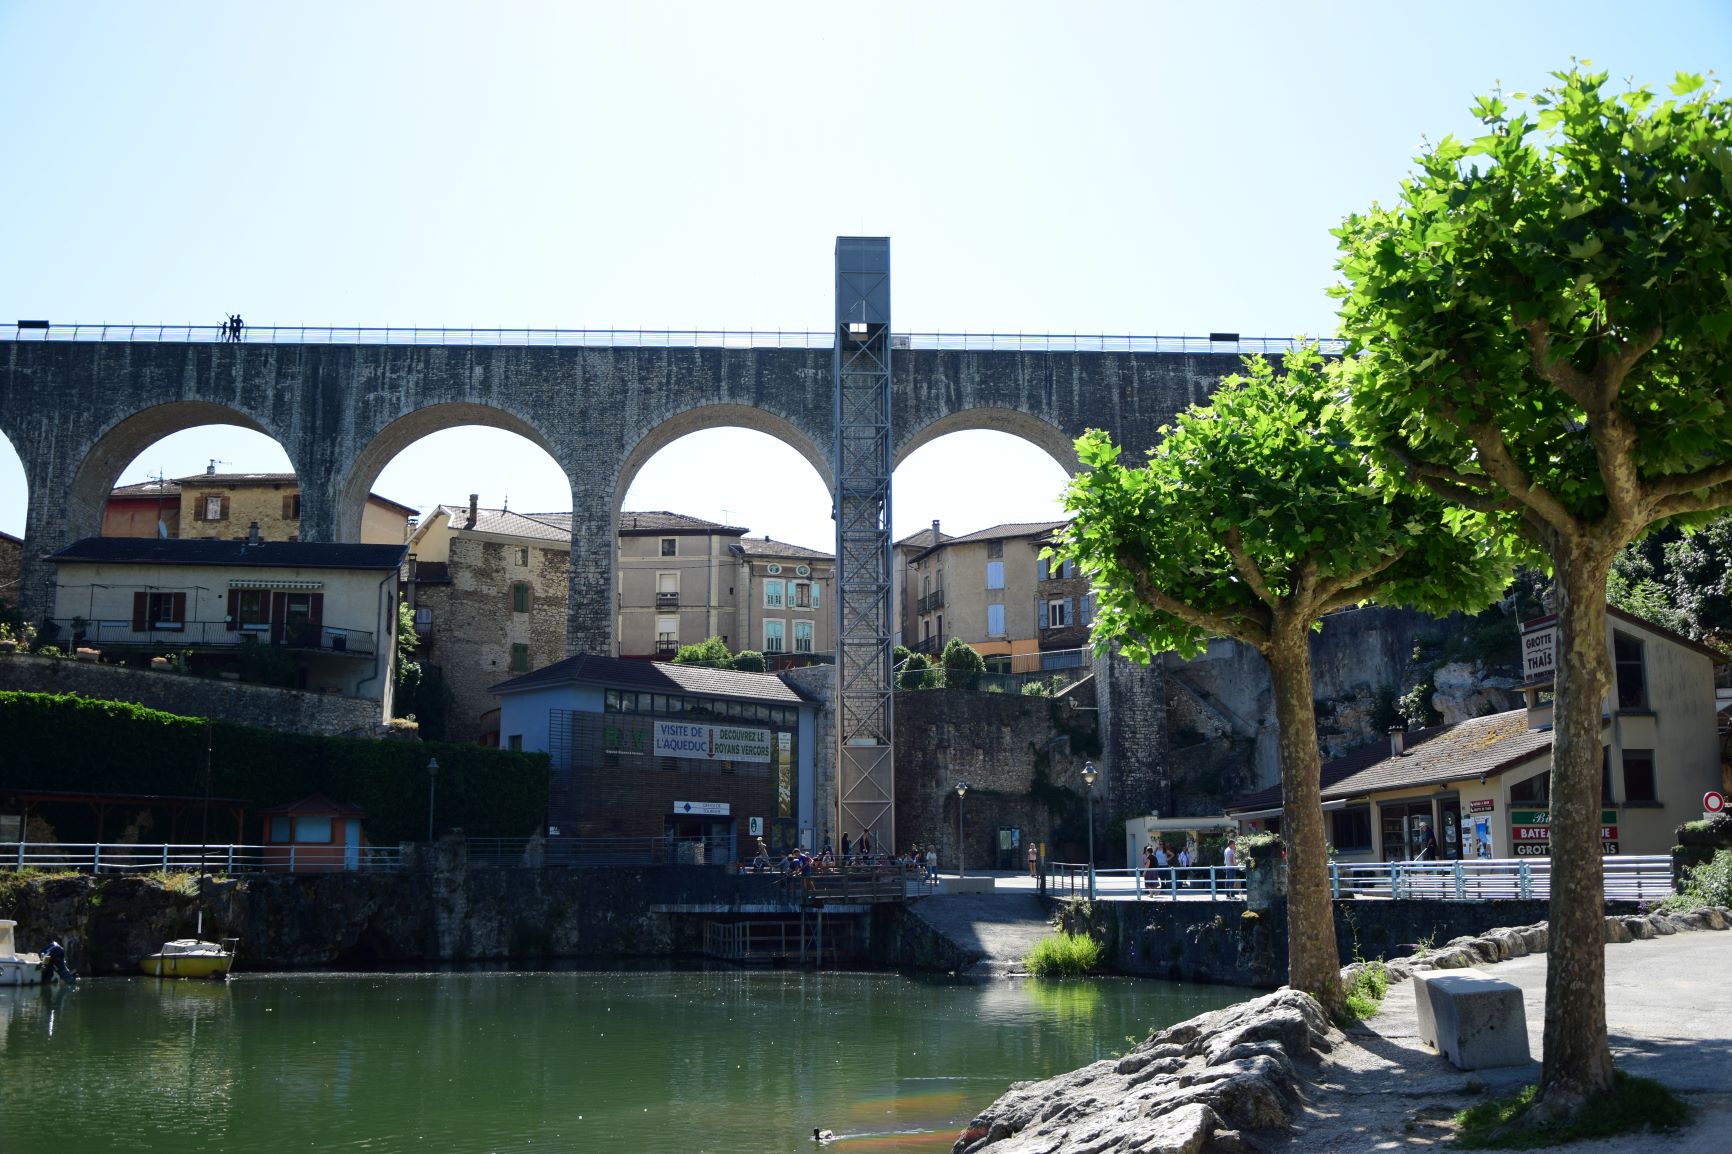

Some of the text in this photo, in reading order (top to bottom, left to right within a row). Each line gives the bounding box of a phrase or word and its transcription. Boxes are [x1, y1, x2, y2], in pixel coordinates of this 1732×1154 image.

[1526, 634, 1551, 649] GROTTE
[1527, 652, 1552, 670] THAÏS
[661, 725, 703, 737] VISITE DE
[720, 729, 756, 742] DECOUVREZ
[757, 732, 765, 742] LE
[657, 738, 707, 752] L'AQUEDUC
[714, 743, 740, 754] ROYANS
[740, 745, 769, 756] VERCORS
[1517, 845, 1548, 855] GROT
